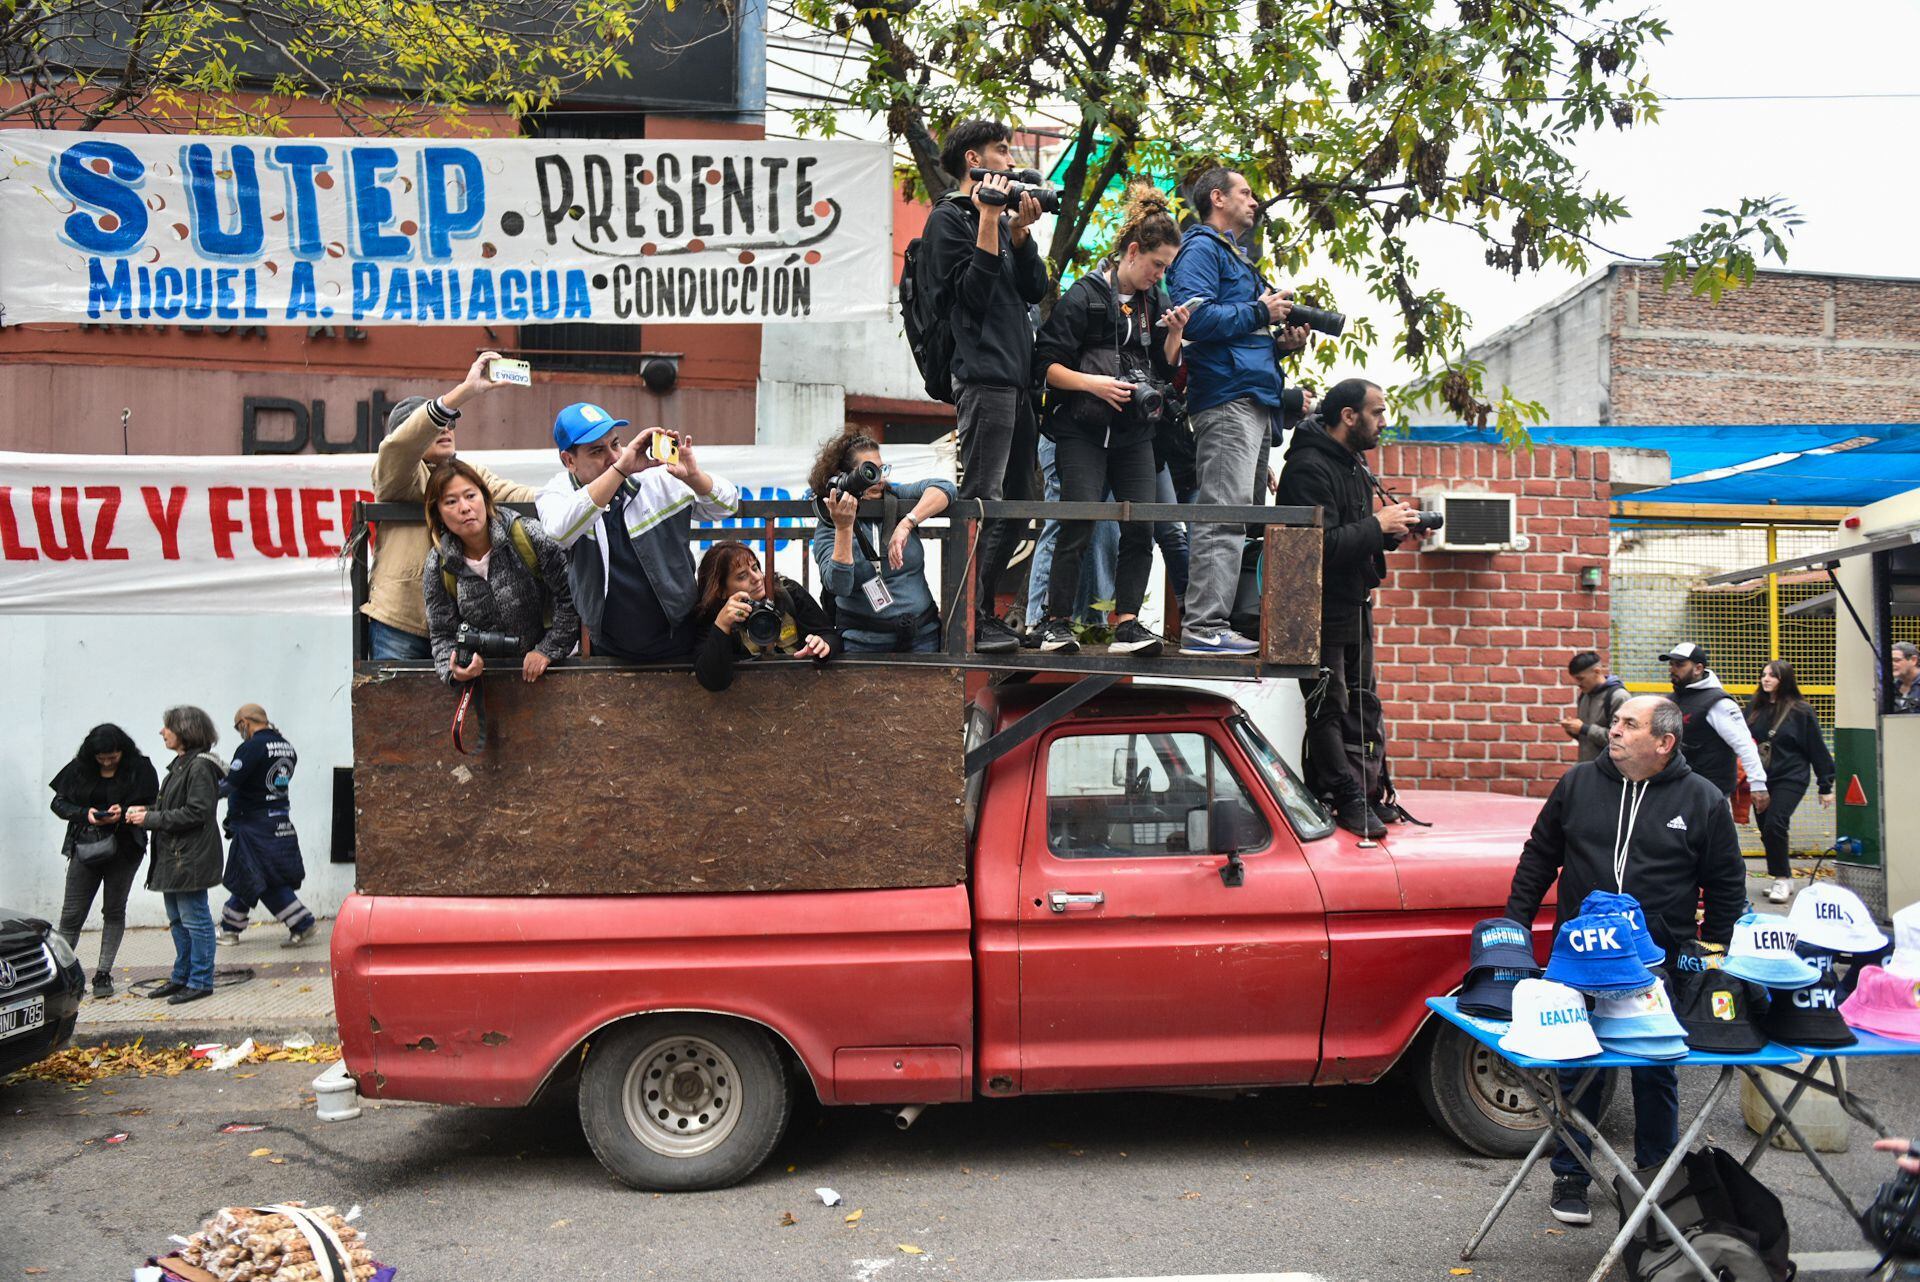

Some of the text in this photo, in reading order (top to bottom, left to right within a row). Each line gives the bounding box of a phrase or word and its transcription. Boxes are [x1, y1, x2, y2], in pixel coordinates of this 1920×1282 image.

[49, 140, 818, 264] SUTEP PRESENTE
[285, 260, 334, 319] A.
[351, 261, 592, 321] PANIAGUA
[613, 252, 811, 319] CONDUCCIÓN
[0, 486, 129, 561] LUZ
[141, 486, 188, 560] Y
[1481, 927, 1526, 949] ARGENTINA
[1569, 927, 1622, 953] CFK
[1791, 989, 1836, 1010] CFK
[22, 1003, 42, 1026] 785
[1540, 1007, 1588, 1027] LEALTAD
